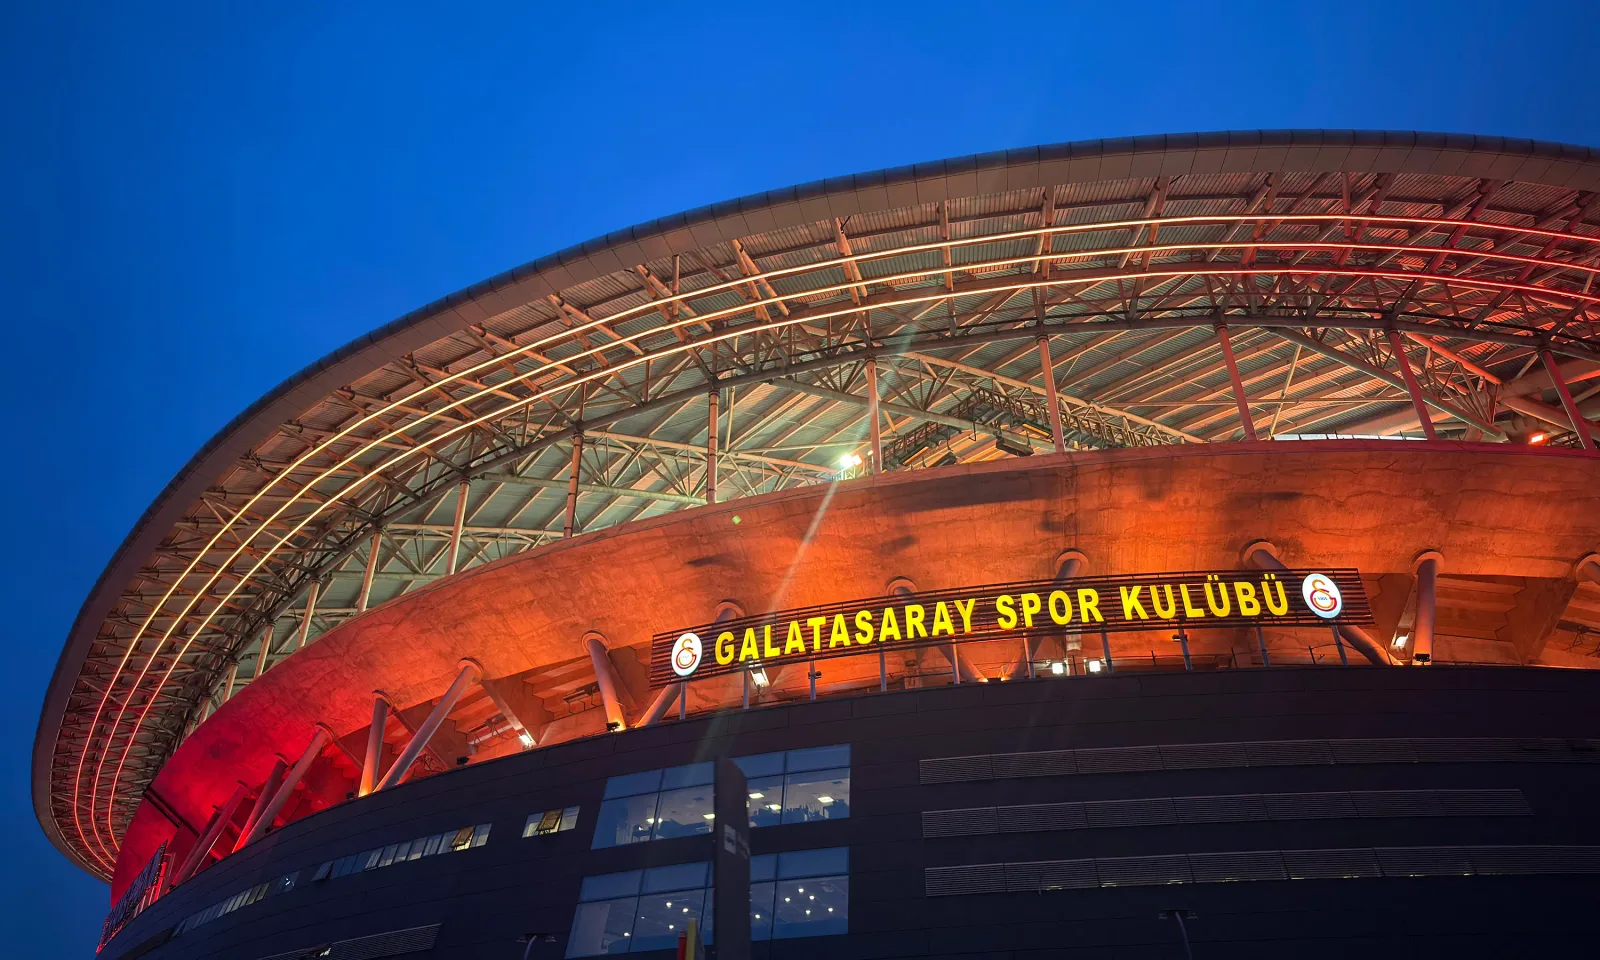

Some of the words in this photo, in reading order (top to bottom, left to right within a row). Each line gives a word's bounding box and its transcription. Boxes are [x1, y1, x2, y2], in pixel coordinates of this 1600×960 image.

[714, 598, 976, 665] GALATASARAY
[995, 588, 1104, 630] SPOR
[1119, 573, 1289, 620] KULÜBÜ
